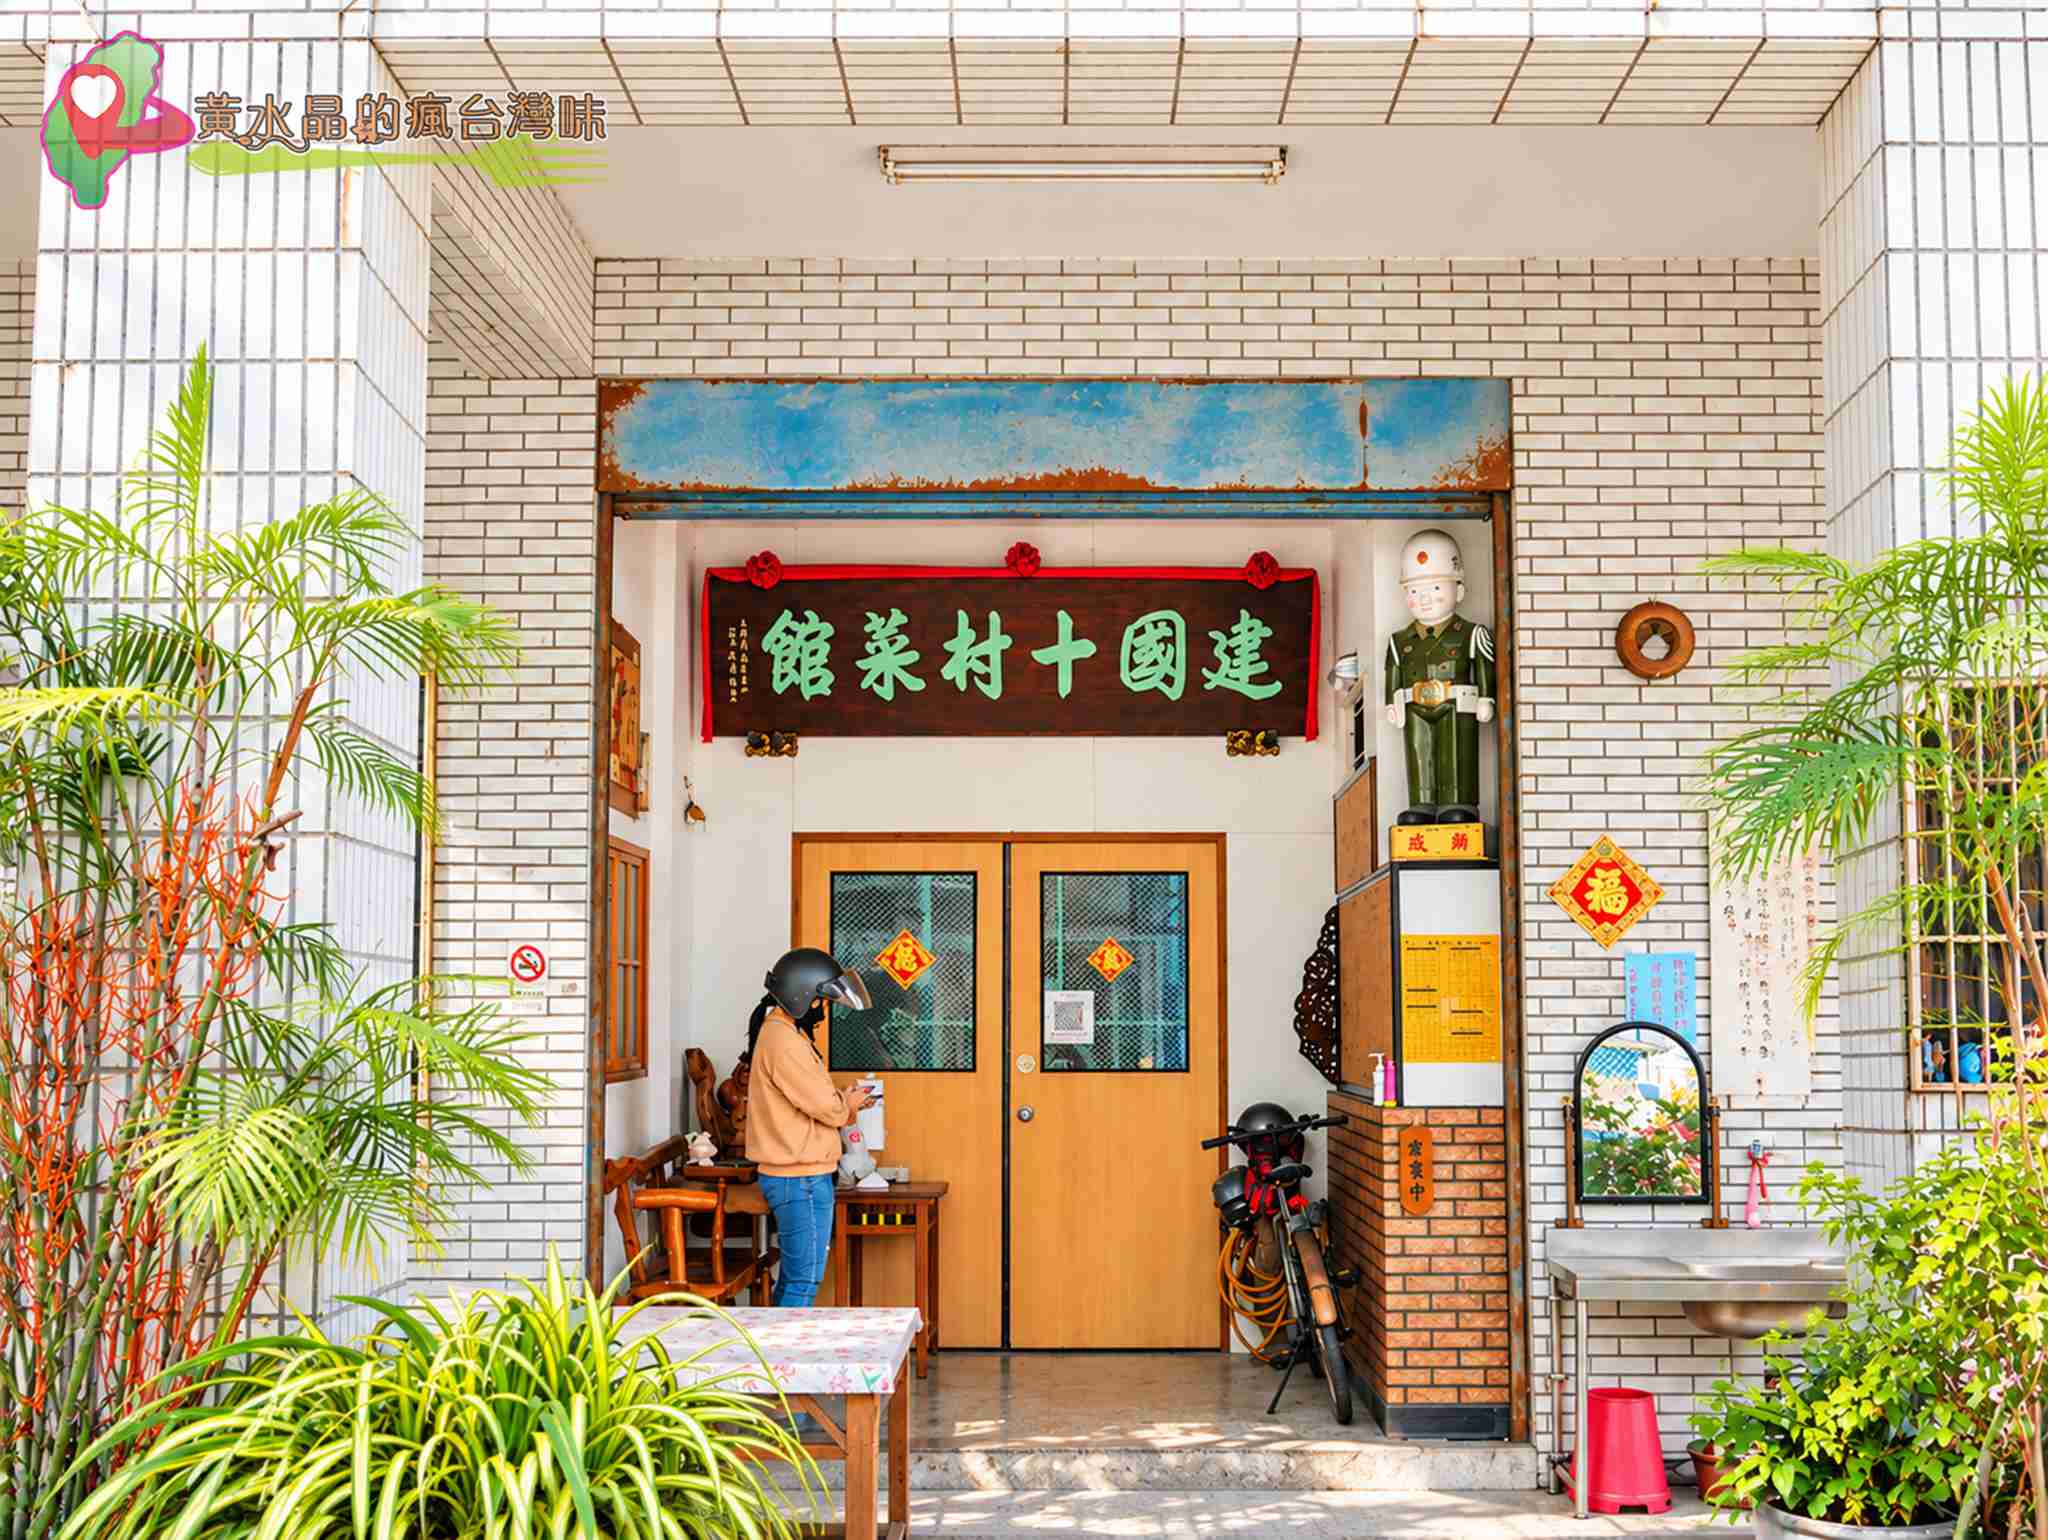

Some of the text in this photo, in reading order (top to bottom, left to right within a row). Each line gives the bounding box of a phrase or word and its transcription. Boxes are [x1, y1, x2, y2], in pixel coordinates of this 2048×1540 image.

[761, 607, 1283, 702] 建國十村菜館
[1584, 867, 1629, 915] 福
